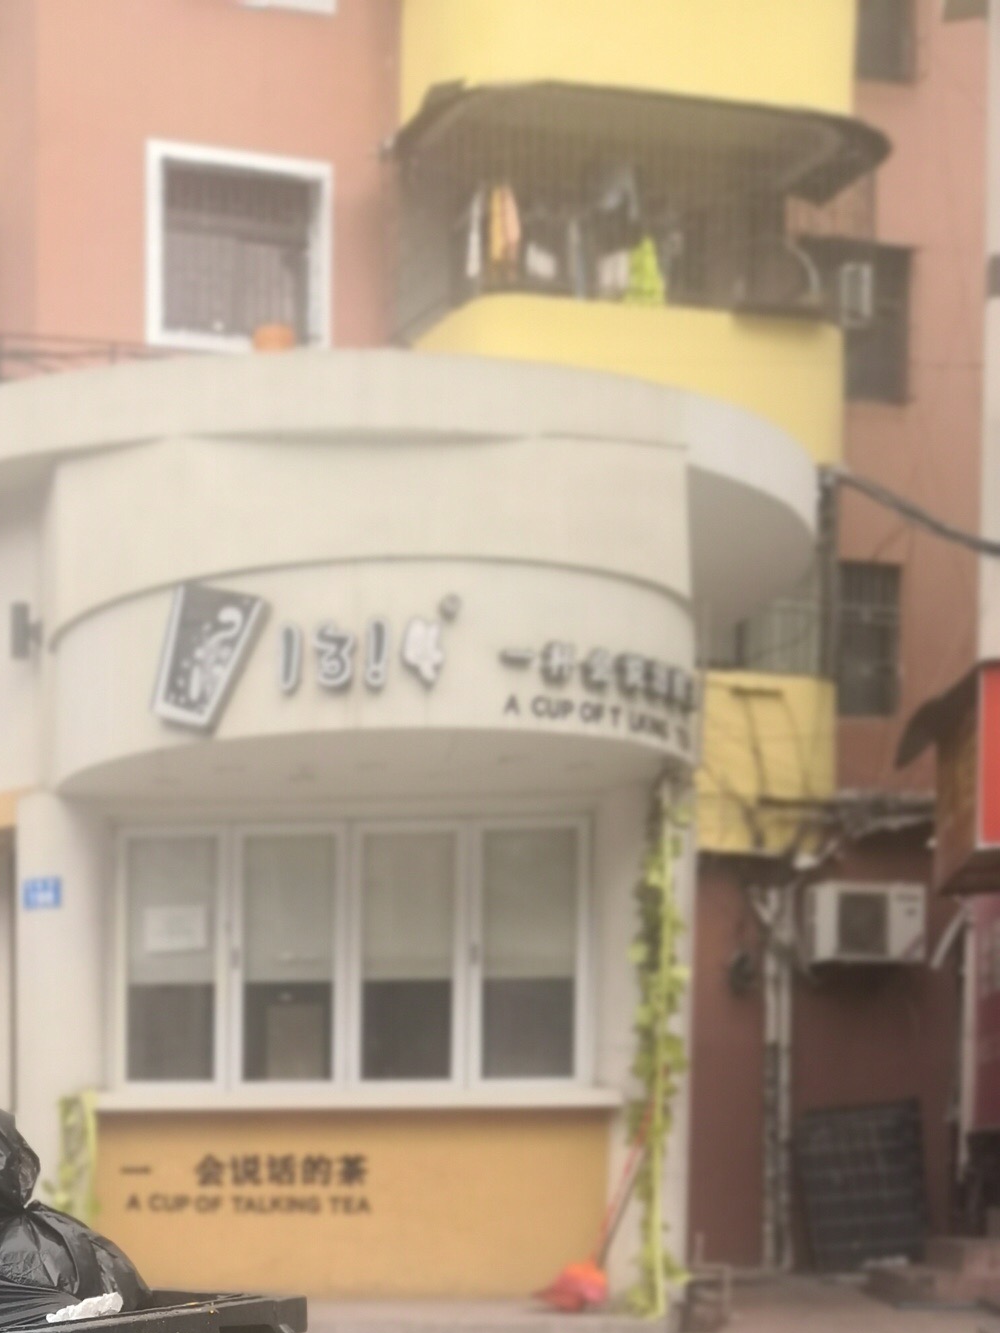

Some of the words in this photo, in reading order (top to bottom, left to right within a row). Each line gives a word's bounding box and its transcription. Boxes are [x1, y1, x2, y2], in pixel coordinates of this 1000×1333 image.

[195, 1154, 368, 1187] 会说话的茶
[126, 1195, 141, 1212] A
[147, 1194, 190, 1213] CUP
[194, 1195, 222, 1214] OF
[232, 1195, 323, 1214] TALKING
[330, 1195, 372, 1214] TEA
